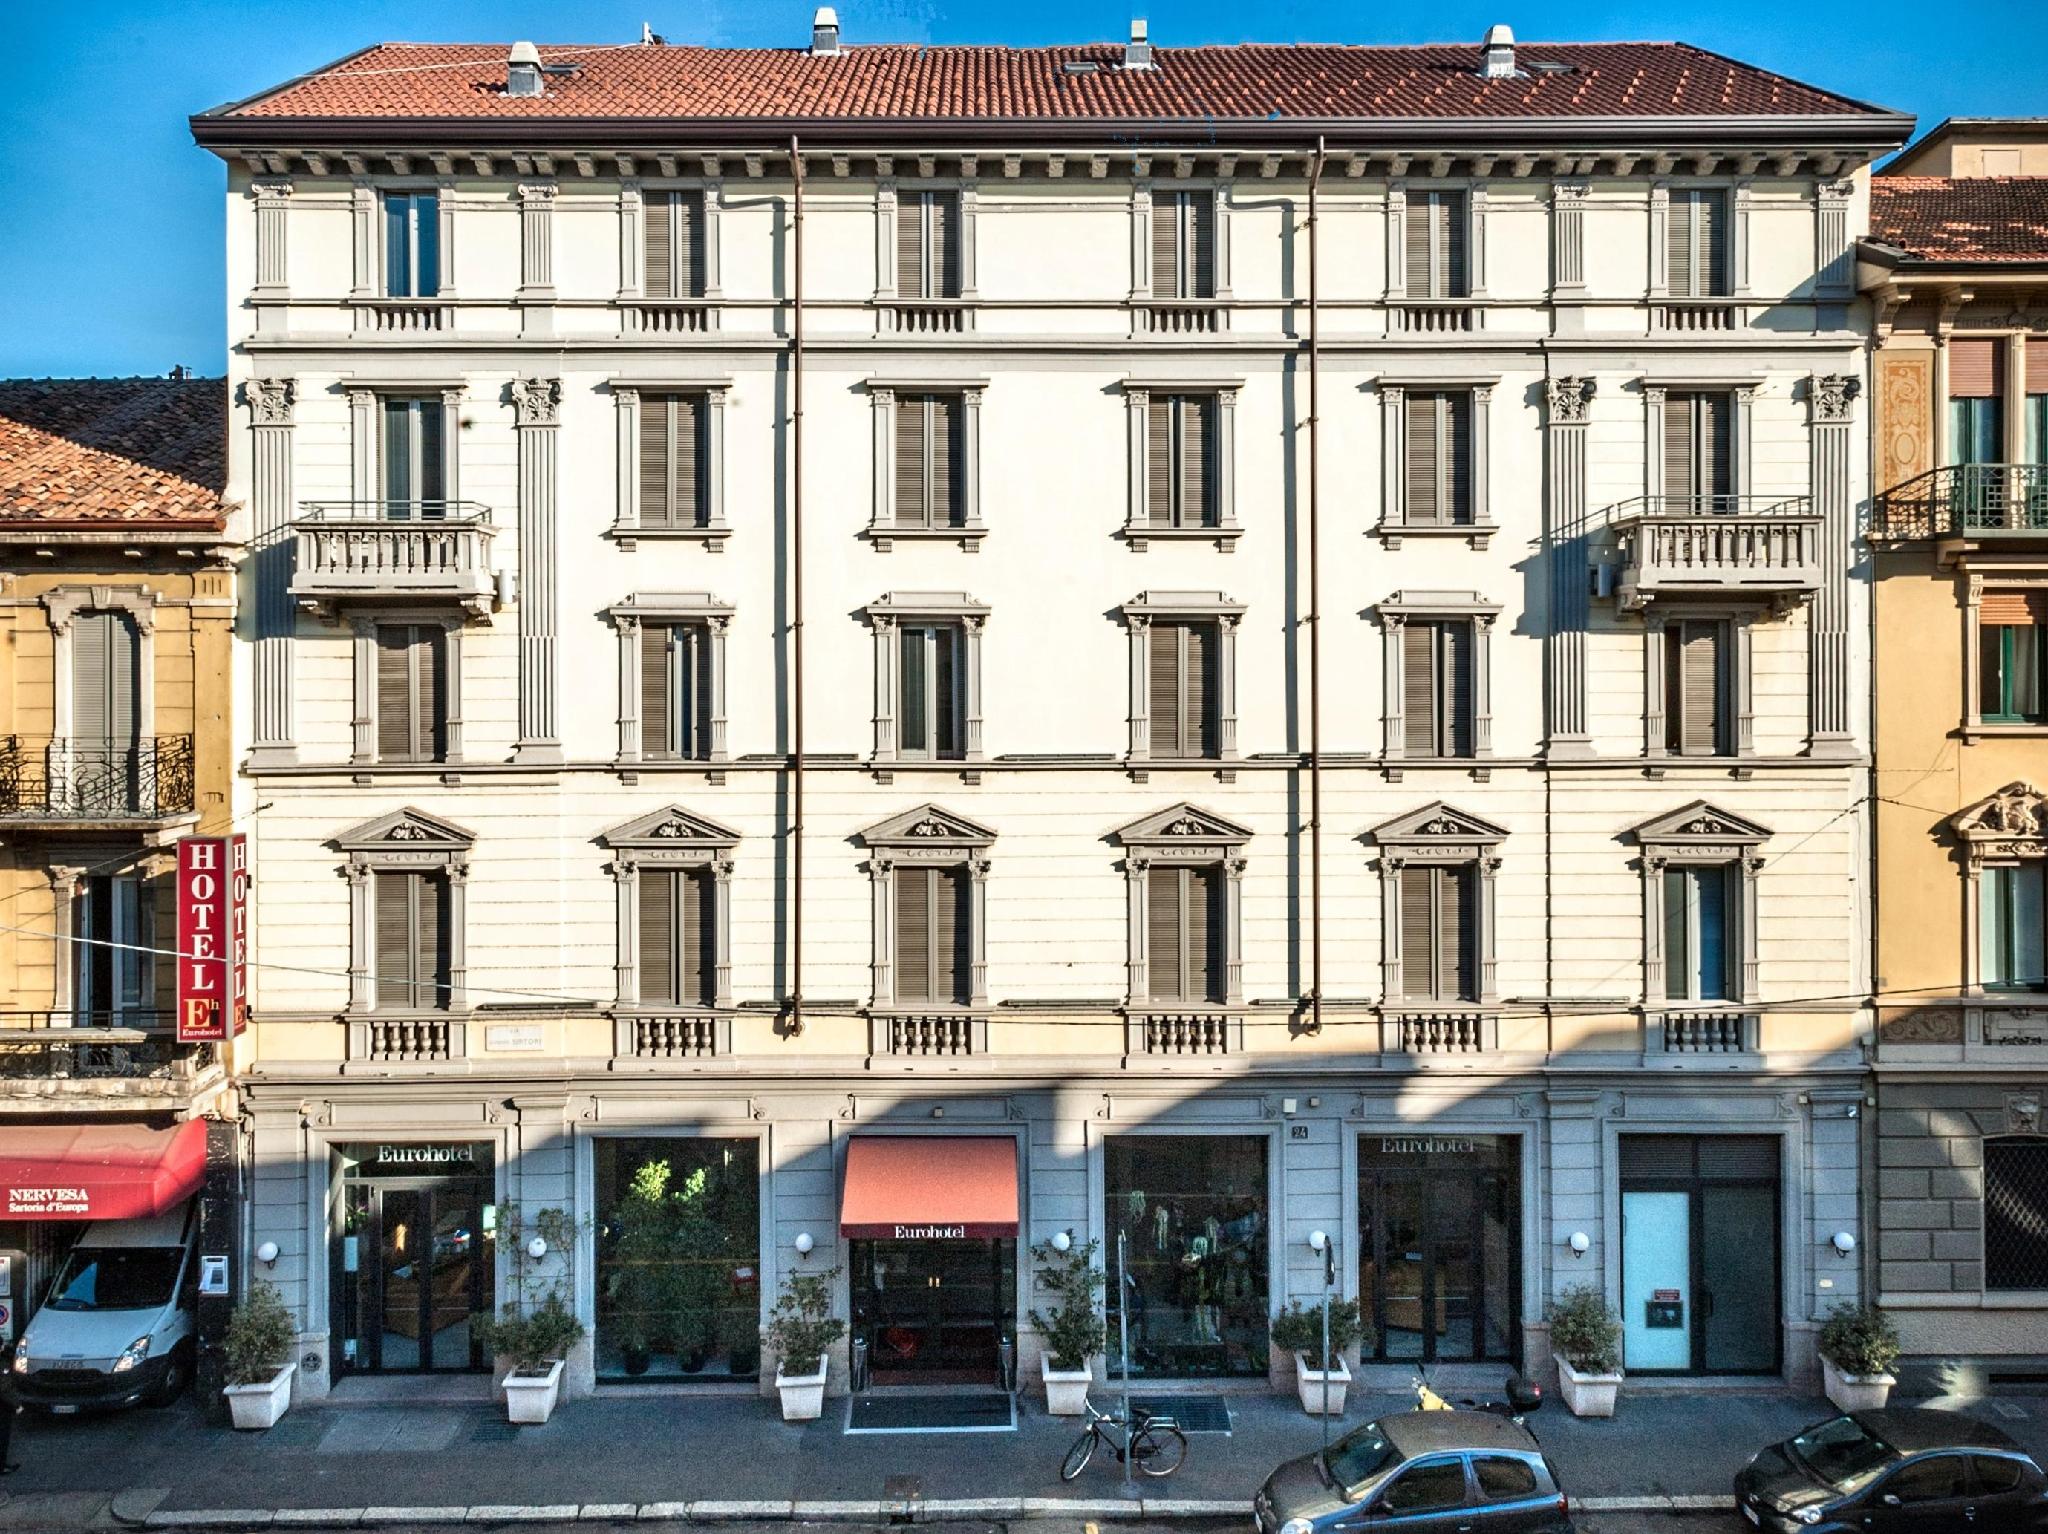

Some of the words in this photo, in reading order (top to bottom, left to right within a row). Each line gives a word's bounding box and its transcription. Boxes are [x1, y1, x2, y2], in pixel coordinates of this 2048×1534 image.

[188, 844, 217, 991] HOTEL
[233, 842, 246, 999] HOTEL
[182, 1028, 222, 1037] Eurohotel
[1294, 1127, 1307, 1137] 24
[1381, 1136, 1475, 1152] Eurohotel
[376, 1144, 473, 1163] Eurohotel
[8, 1188, 89, 1202] NERVESA
[8, 1202, 45, 1213] Sartoria
[894, 1225, 966, 1239] Eurohotel
